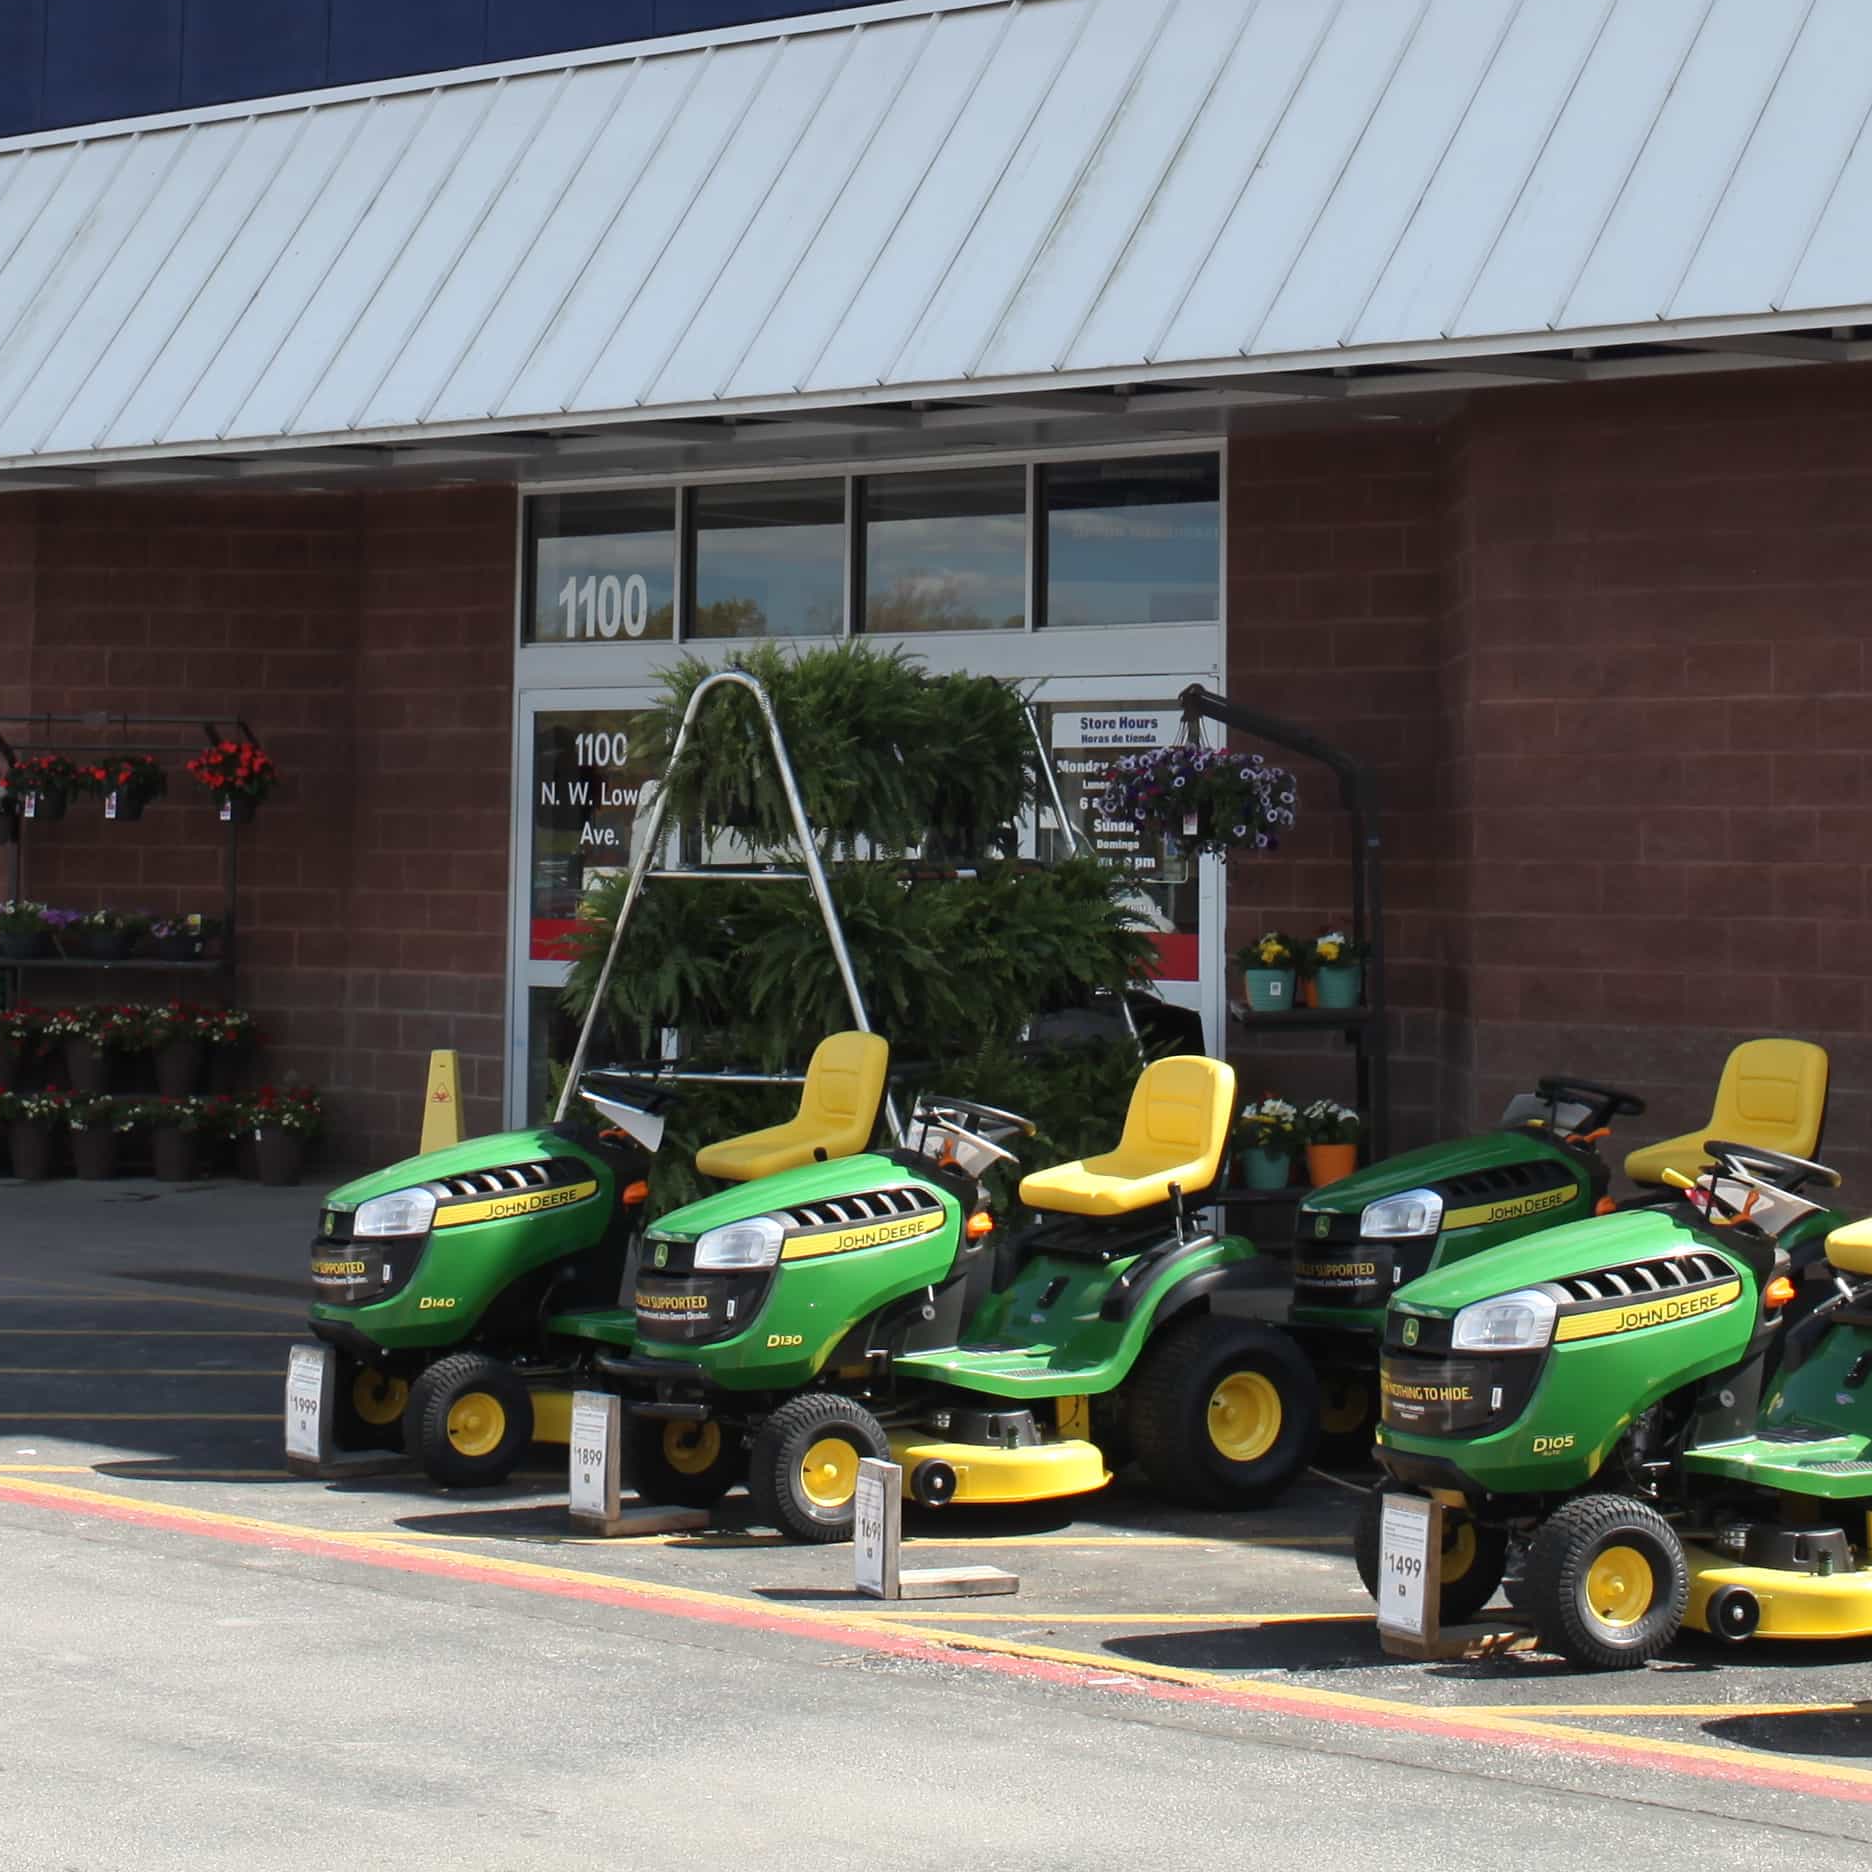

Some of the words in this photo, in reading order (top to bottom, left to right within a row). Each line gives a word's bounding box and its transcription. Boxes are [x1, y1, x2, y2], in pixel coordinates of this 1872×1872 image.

[559, 574, 648, 638] 1100
[1080, 716, 1116, 730] Store
[1120, 715, 1158, 729] Hours
[575, 732, 628, 767] 1100
[1081, 733, 1109, 744] Horas
[1112, 733, 1123, 743] de
[1126, 732, 1156, 743] tienda
[541, 781, 560, 806] N.
[568, 781, 594, 806] W.
[580, 821, 620, 846] Ave.
[1096, 840, 1140, 851] Domingo
[485, 1201, 527, 1218] JOHN
[530, 1189, 577, 1209] DEERE
[1487, 1202, 1523, 1222] JOHN
[1524, 1192, 1563, 1213] DEERE
[833, 1232, 876, 1249] JOHN
[879, 1221, 925, 1241] DEERE
[419, 1297, 456, 1309] D140
[1615, 1306, 1663, 1329] JOHN
[1666, 1293, 1719, 1318] DEERE
[767, 1334, 803, 1347] D130
[1424, 1387, 1439, 1401] TO
[1440, 1387, 1473, 1401] HIDE.
[1533, 1435, 1575, 1452] D105
